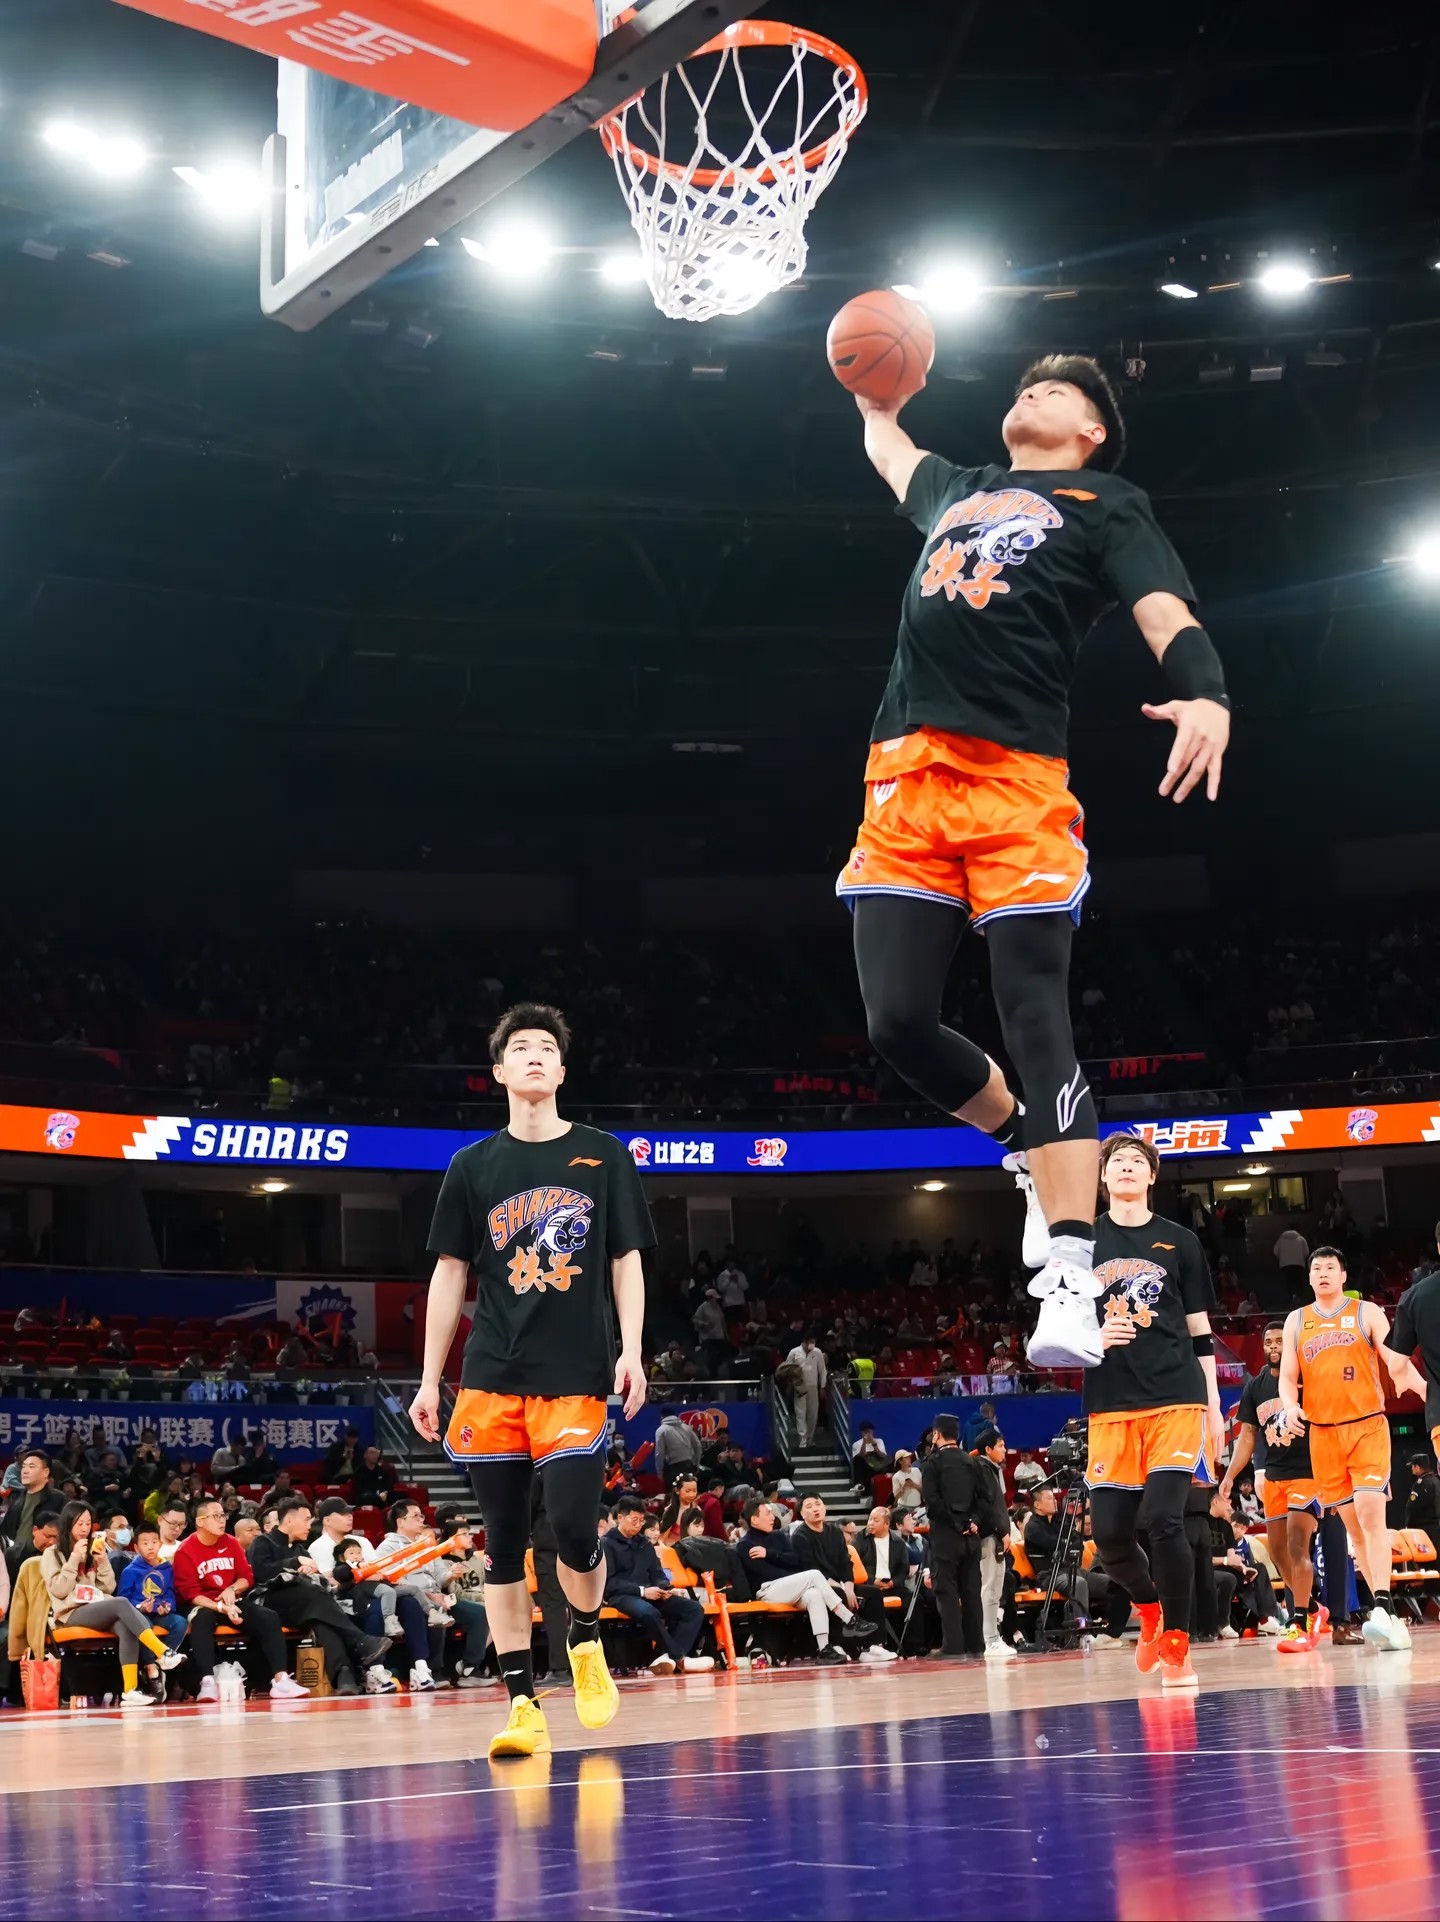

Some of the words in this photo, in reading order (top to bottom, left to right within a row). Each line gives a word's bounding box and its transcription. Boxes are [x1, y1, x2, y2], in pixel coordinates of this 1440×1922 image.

[192, 1124, 349, 1162] SHARKS
[655, 1141, 715, 1164] 以城之名
[1130, 1120, 1232, 1155] 上海
[488, 1186, 595, 1250] SHARKS
[1343, 1366, 1355, 1381] 9
[0, 1412, 350, 1449] 子篮球职业联赛（上海赛区
